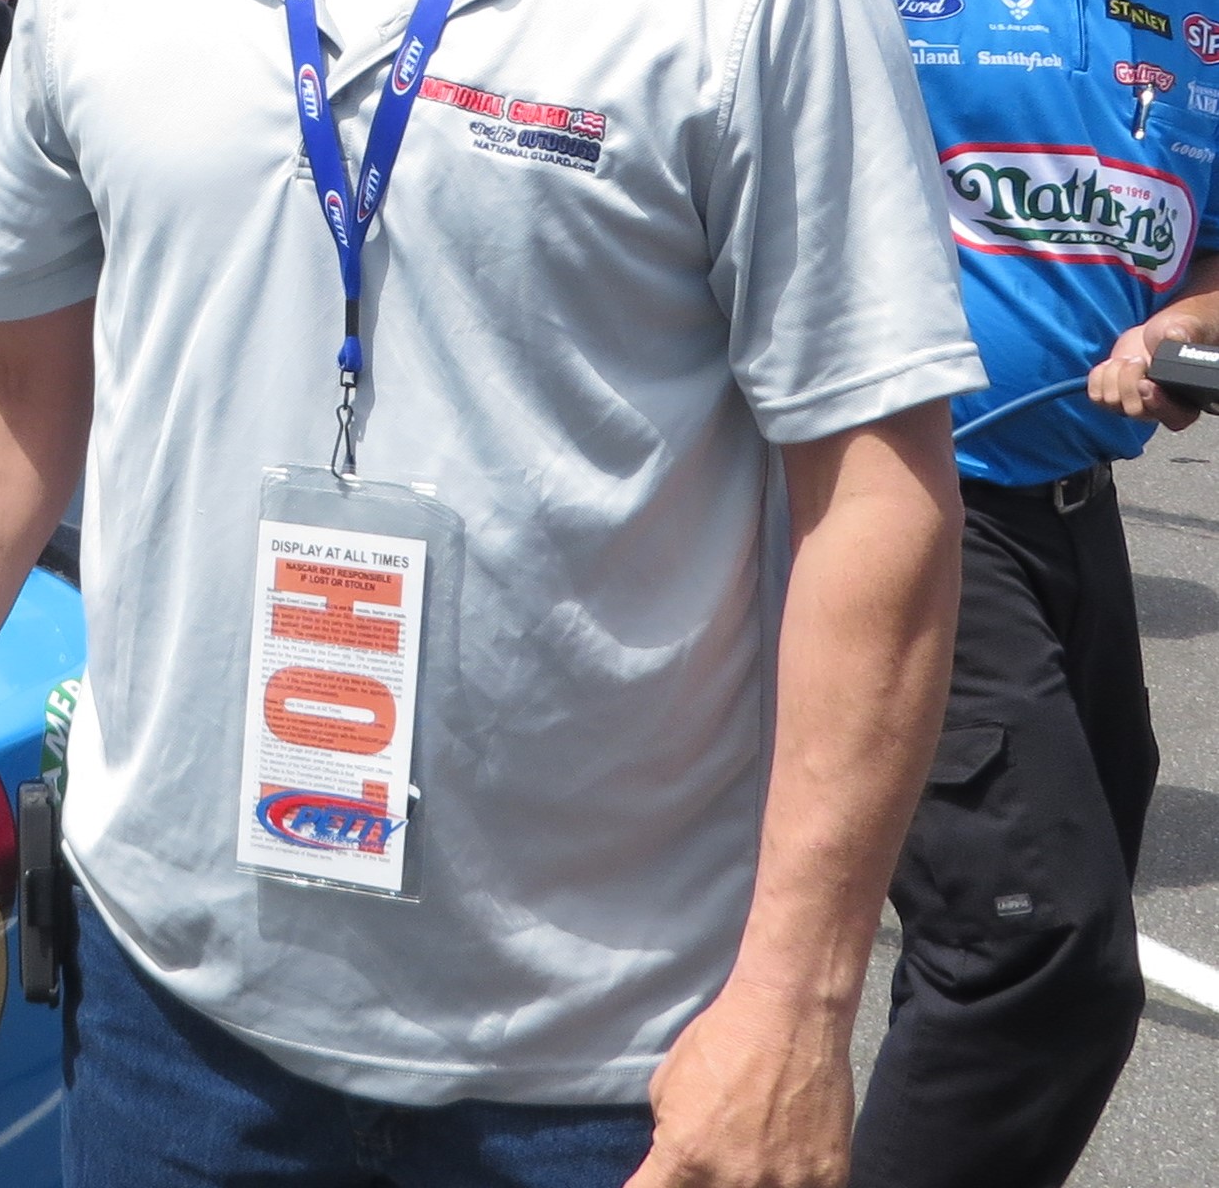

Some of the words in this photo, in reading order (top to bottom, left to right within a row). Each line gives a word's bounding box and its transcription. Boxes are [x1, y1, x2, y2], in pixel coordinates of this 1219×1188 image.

[400, 35, 425, 84] PETTY
[302, 77, 321, 122] PETTY
[417, 76, 506, 120] NATIONAL
[507, 98, 571, 131] GUARD
[362, 162, 381, 210] PETTY
[1125, 184, 1151, 201] 1916
[331, 196, 351, 250] PETTY
[271, 539, 323, 558] DISPLAY
[325, 547, 341, 560] AT
[344, 549, 368, 563] ALL
[372, 552, 410, 569] TIMES
[285, 562, 318, 574] NASCAR
[319, 567, 335, 576] NOT
[337, 568, 392, 584] RESPONSIBLE
[300, 574, 307, 582] IF
[309, 575, 329, 585] LOST
[330, 578, 343, 587] OR
[344, 579, 376, 592] STOLEN
[290, 804, 409, 846] PETTY
